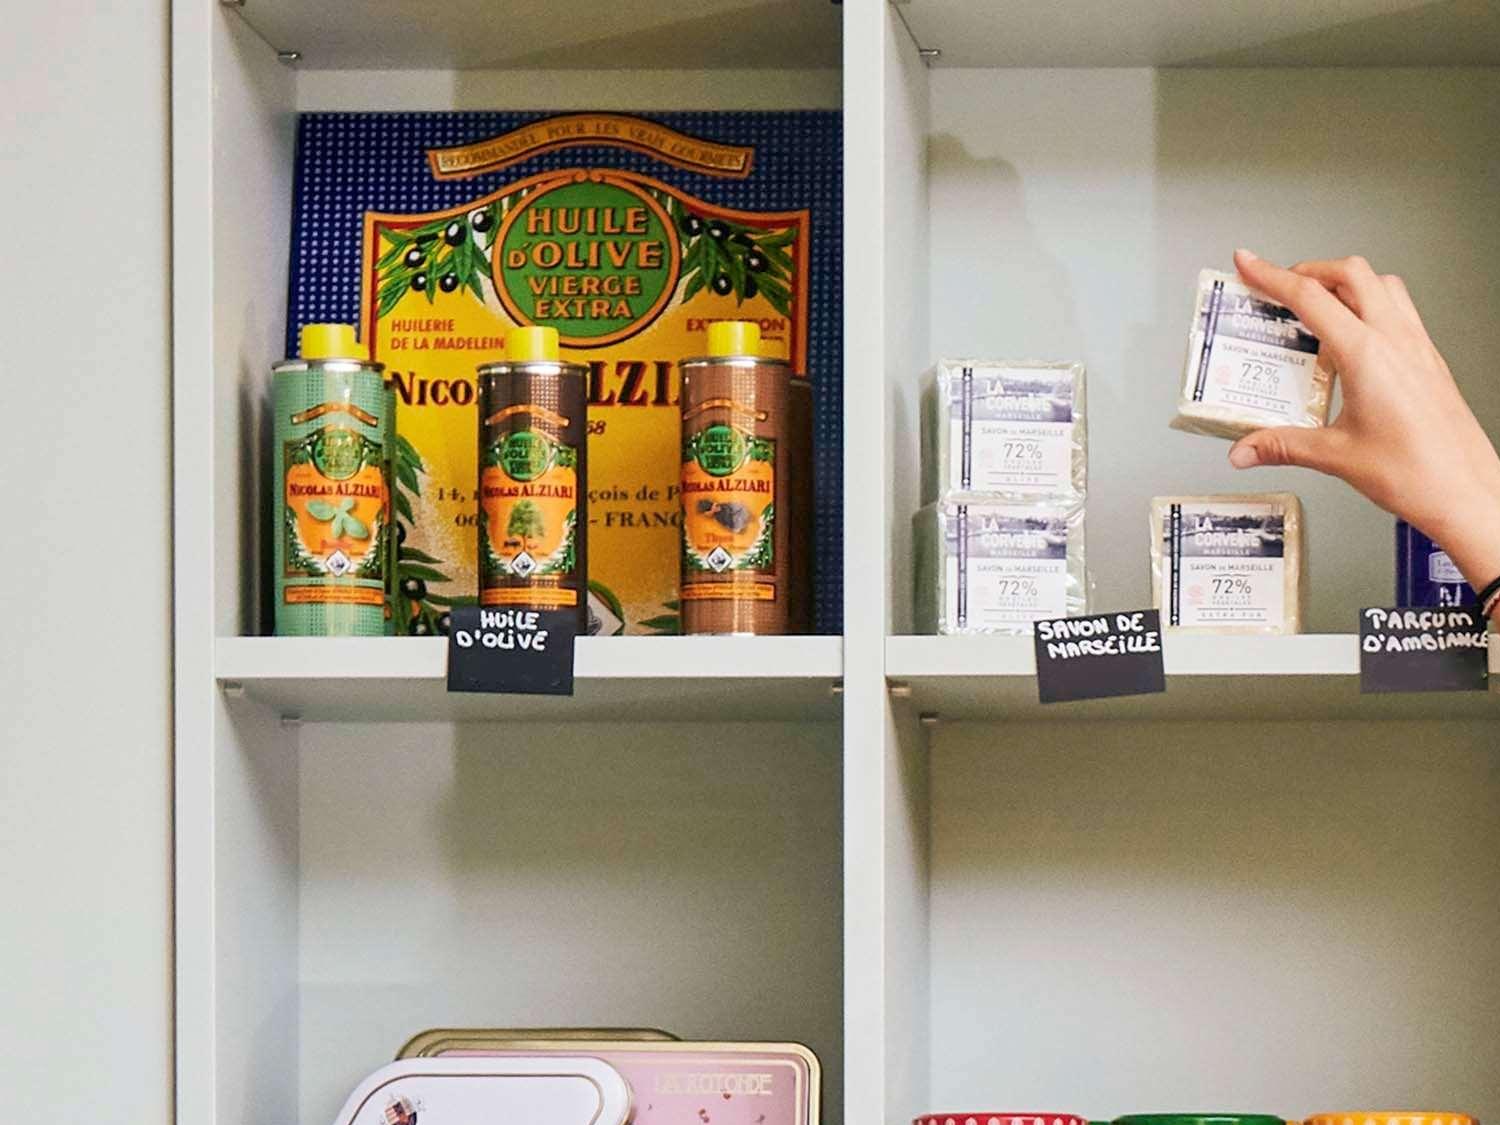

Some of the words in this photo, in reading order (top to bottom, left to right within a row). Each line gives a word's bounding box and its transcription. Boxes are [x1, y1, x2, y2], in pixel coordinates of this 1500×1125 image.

[527, 207, 648, 235] HUILE
[529, 276, 642, 297] VIERGE
[533, 300, 633, 319] EXTRA
[391, 319, 455, 333] HUILERIE
[390, 338, 409, 351] DE
[411, 338, 430, 350] LA
[433, 337, 505, 351] MADELEIN
[1241, 362, 1281, 385] 72%
[1004, 442, 1043, 459] 72%
[520, 484, 574, 499] ALZIARI
[640, 485, 660, 501] de
[717, 479, 770, 494] ALZIARI
[605, 511, 680, 528] FRANC
[1195, 516, 1215, 532] LA
[1190, 563, 1217, 572] SAVON
[1227, 563, 1274, 572] MARSEILLE
[999, 580, 1039, 597] 72%
[1211, 578, 1252, 595] 72%
[1036, 616, 1110, 642] SAVON
[1114, 612, 1145, 633] DE
